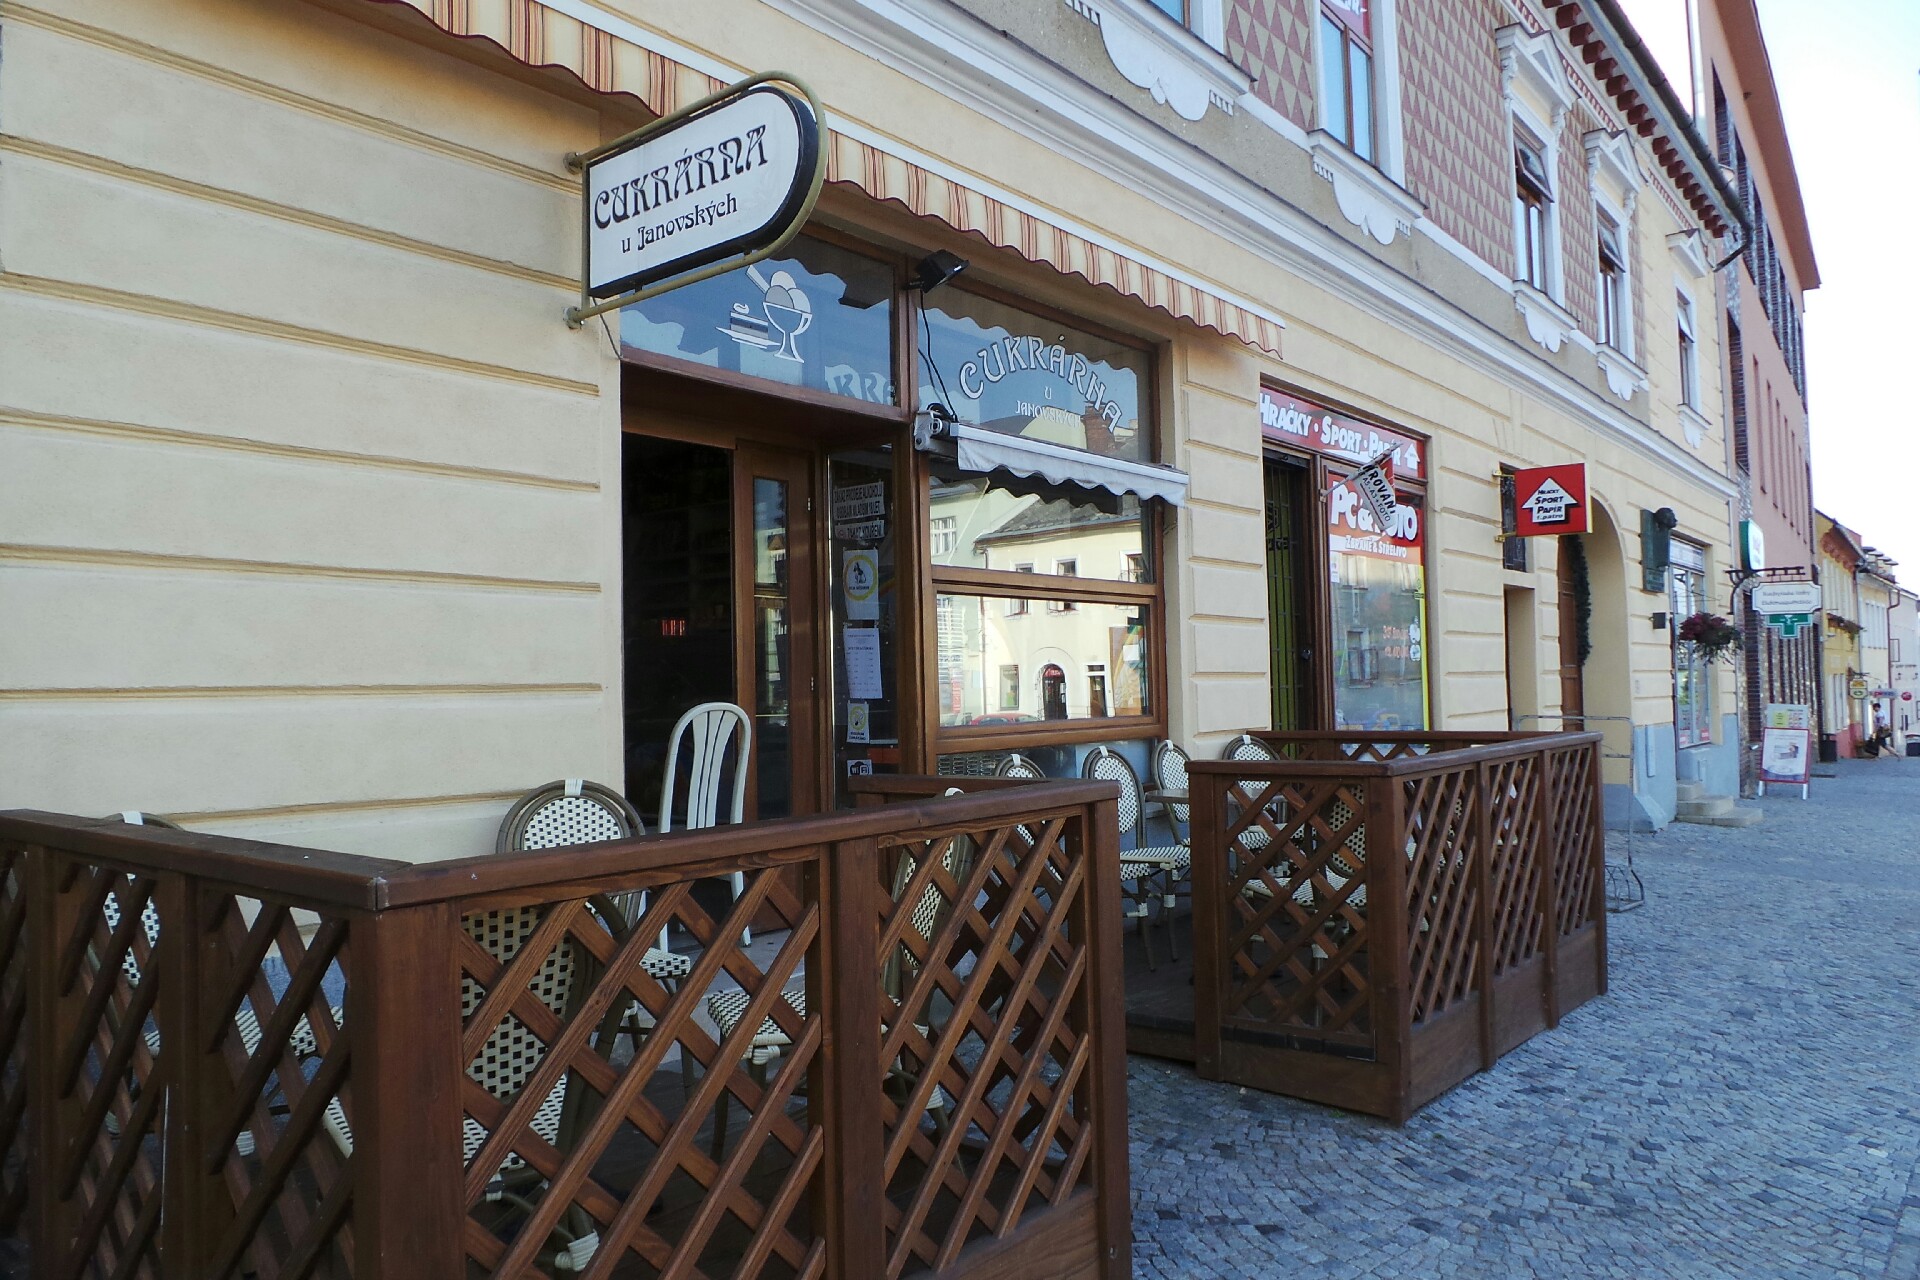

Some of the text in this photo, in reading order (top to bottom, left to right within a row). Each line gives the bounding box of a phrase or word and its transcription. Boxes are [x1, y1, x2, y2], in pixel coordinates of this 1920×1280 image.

[594, 124, 768, 229] CUKRÁRNA
[621, 192, 738, 253] u Janovských
[959, 334, 1123, 434] CUKRÁRNA
[1320, 415, 1362, 453] SPORT
[1331, 481, 1358, 528] PC
[1534, 495, 1564, 504] SPORT
